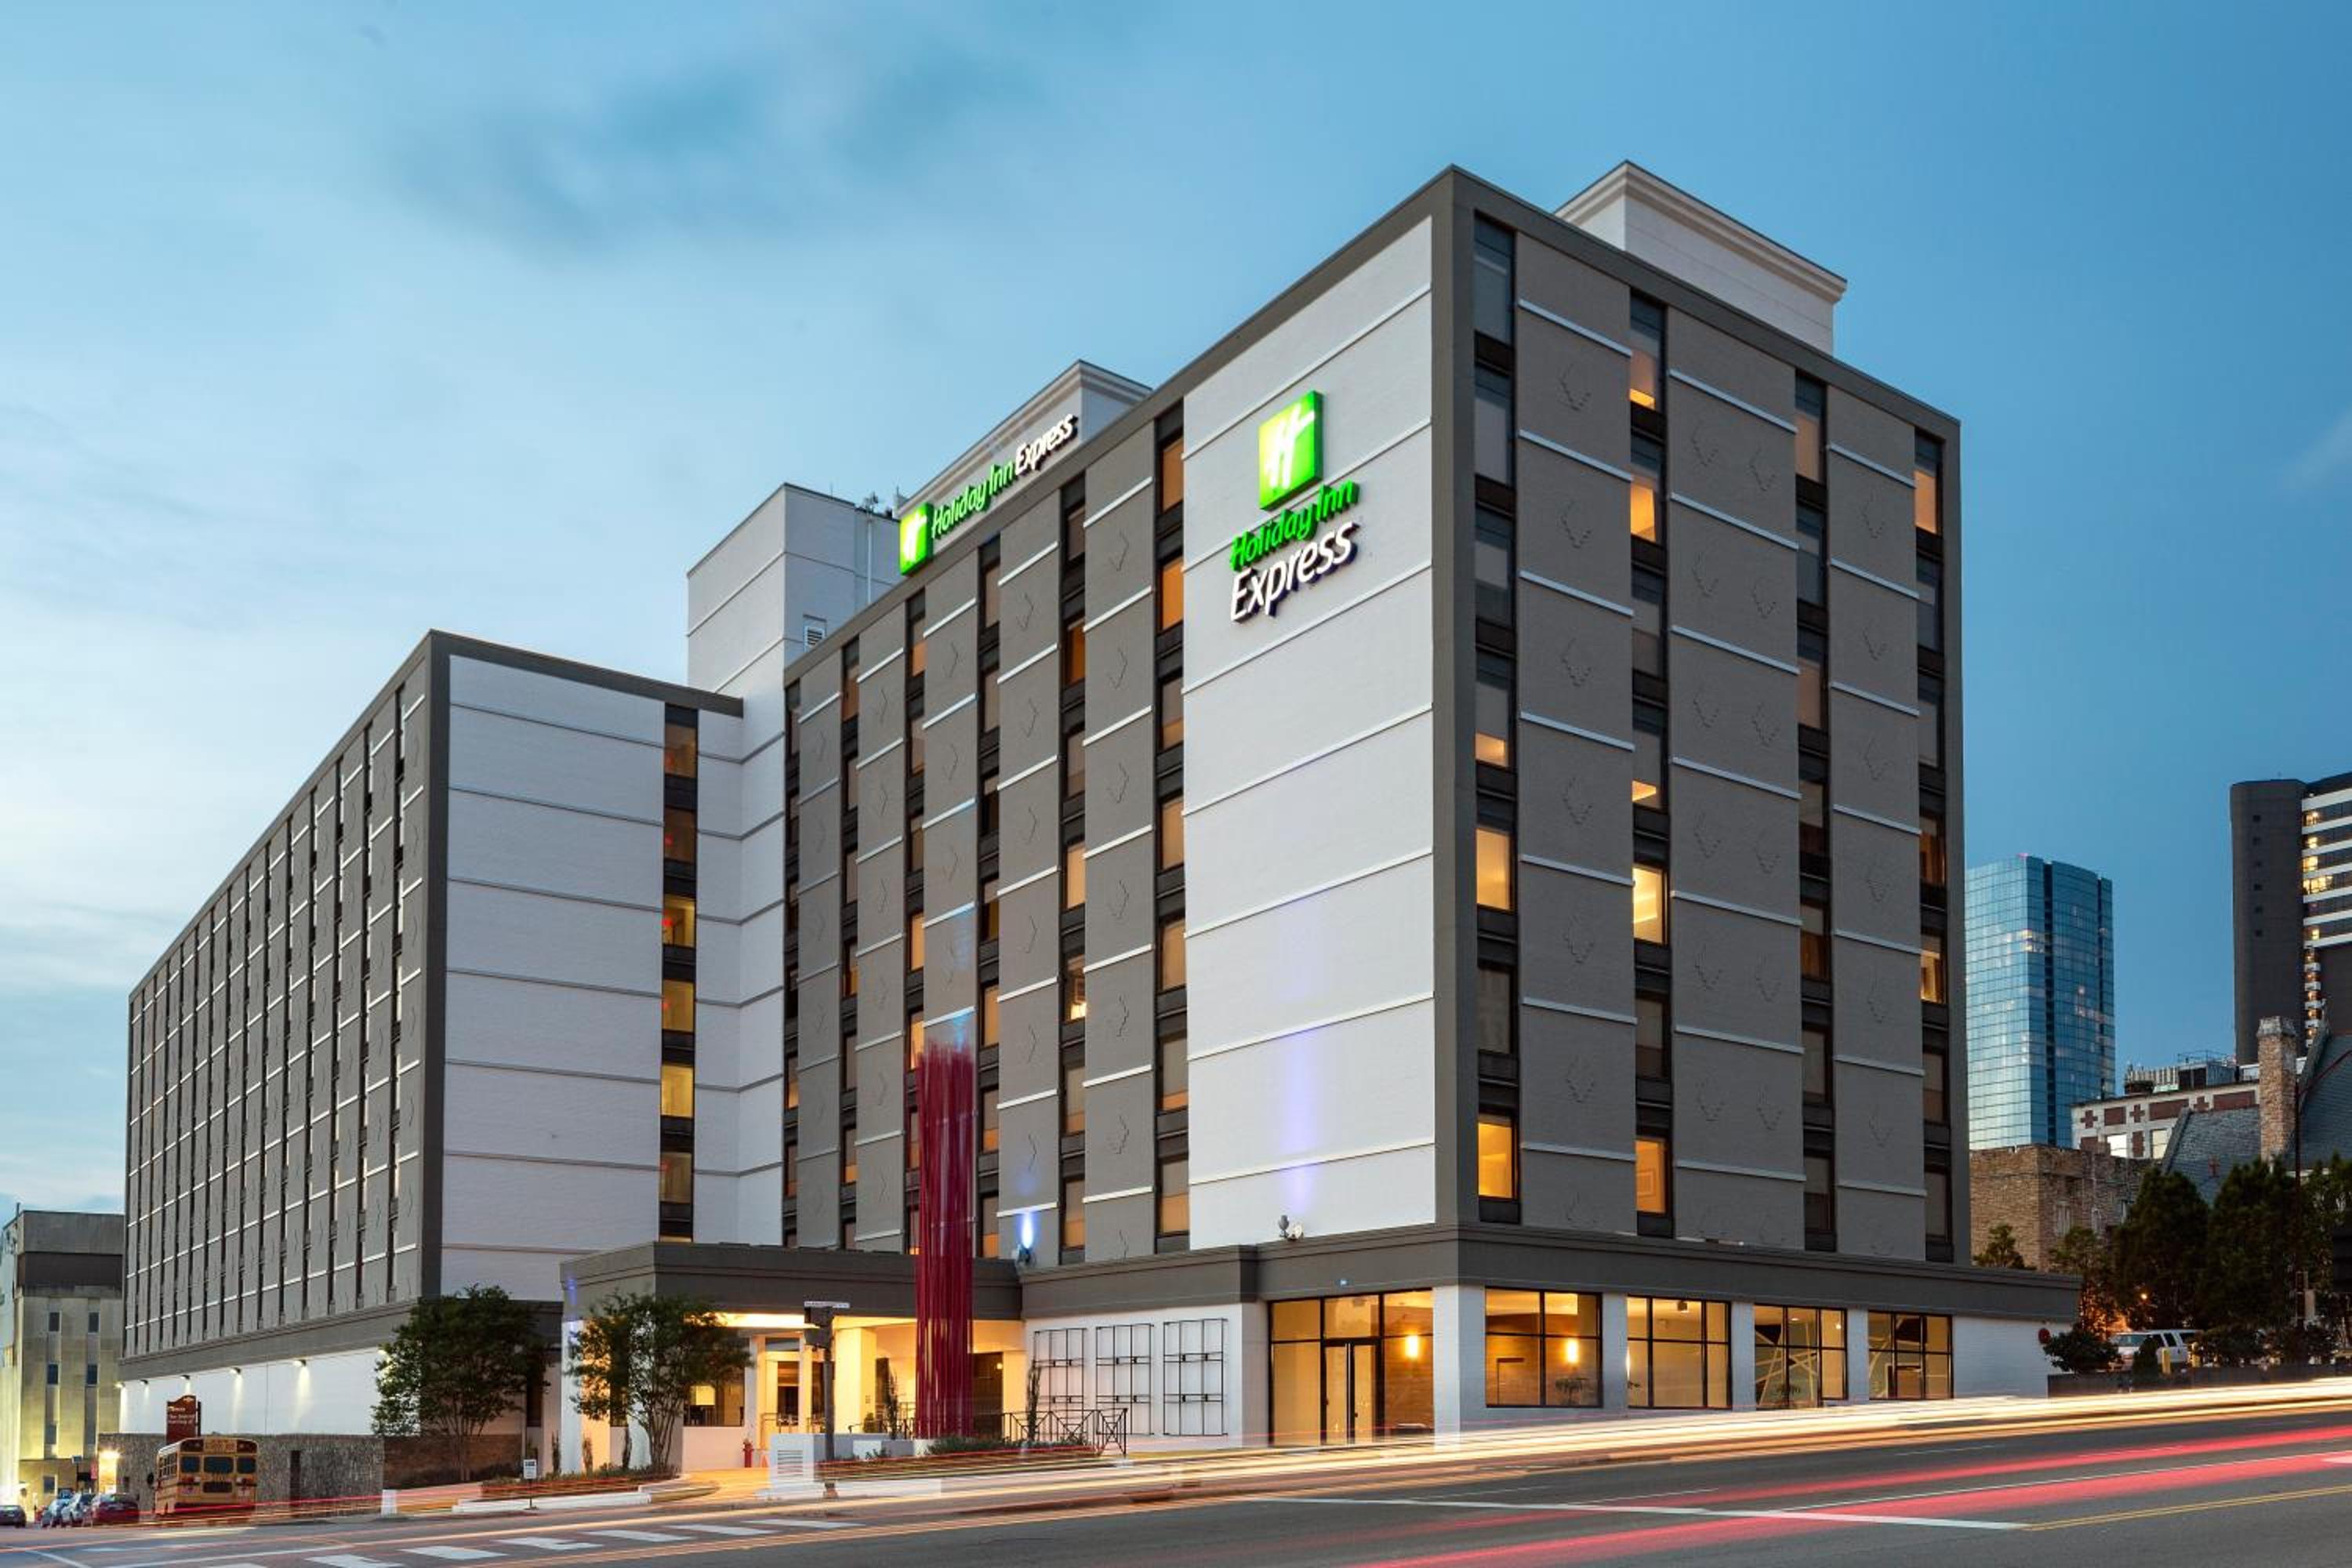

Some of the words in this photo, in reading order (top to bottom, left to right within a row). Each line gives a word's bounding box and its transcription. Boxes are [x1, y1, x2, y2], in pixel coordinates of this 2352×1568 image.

[931, 478, 990, 539] Holiday
[988, 461, 1018, 495] Inn
[1014, 413, 1079, 476] Express
[1229, 502, 1319, 572] Holiday
[1316, 479, 1360, 523] Inn
[1230, 521, 1360, 624] Express
